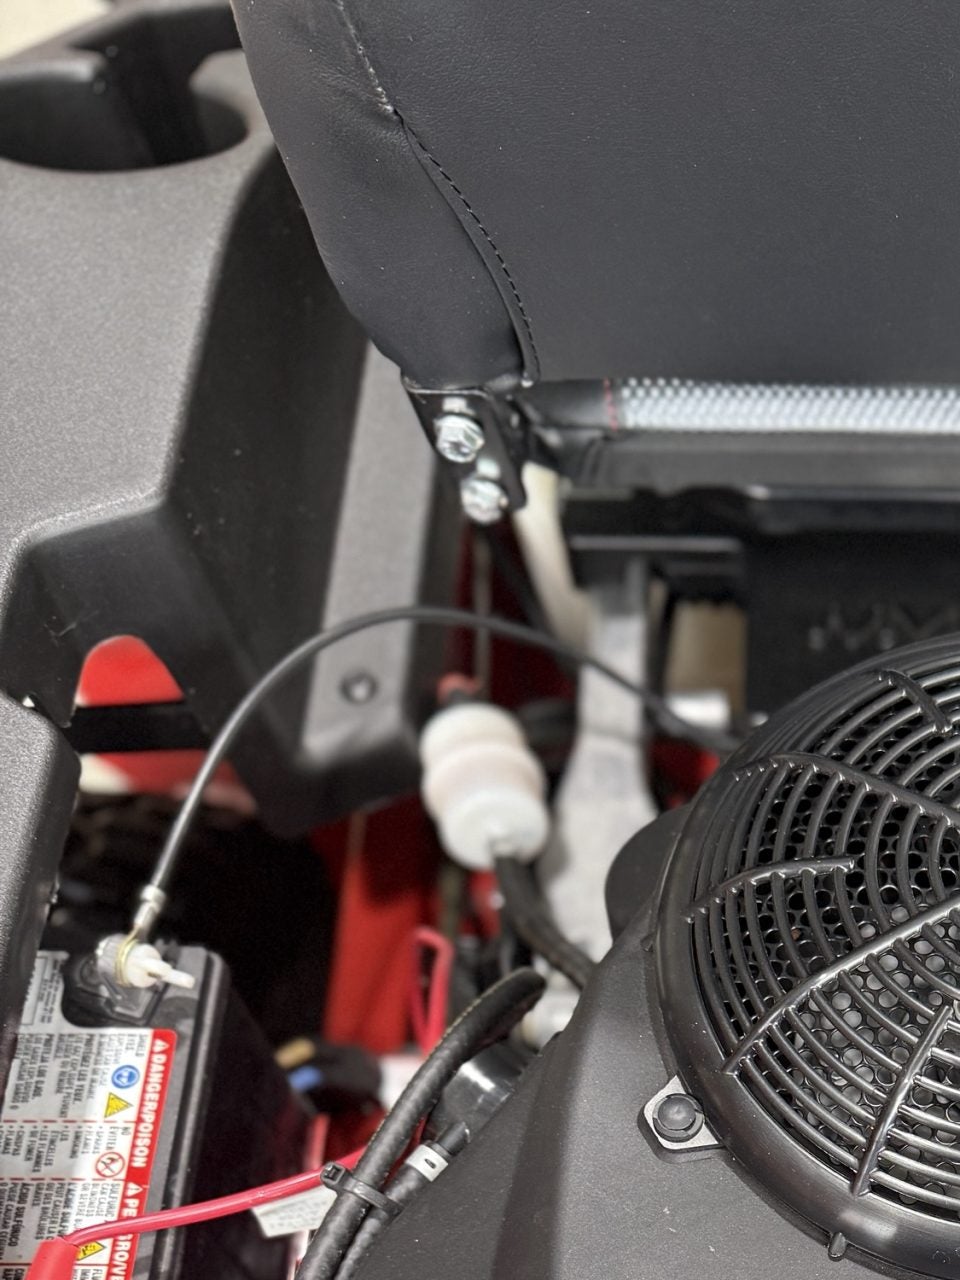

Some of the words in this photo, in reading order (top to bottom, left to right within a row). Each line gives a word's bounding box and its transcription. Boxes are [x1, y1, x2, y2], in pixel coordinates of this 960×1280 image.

[130, 1053, 167, 1168] DANGER/POISON
[48, 1199, 63, 1226] CAUSER
[104, 1182, 121, 1218] SULFURIC
